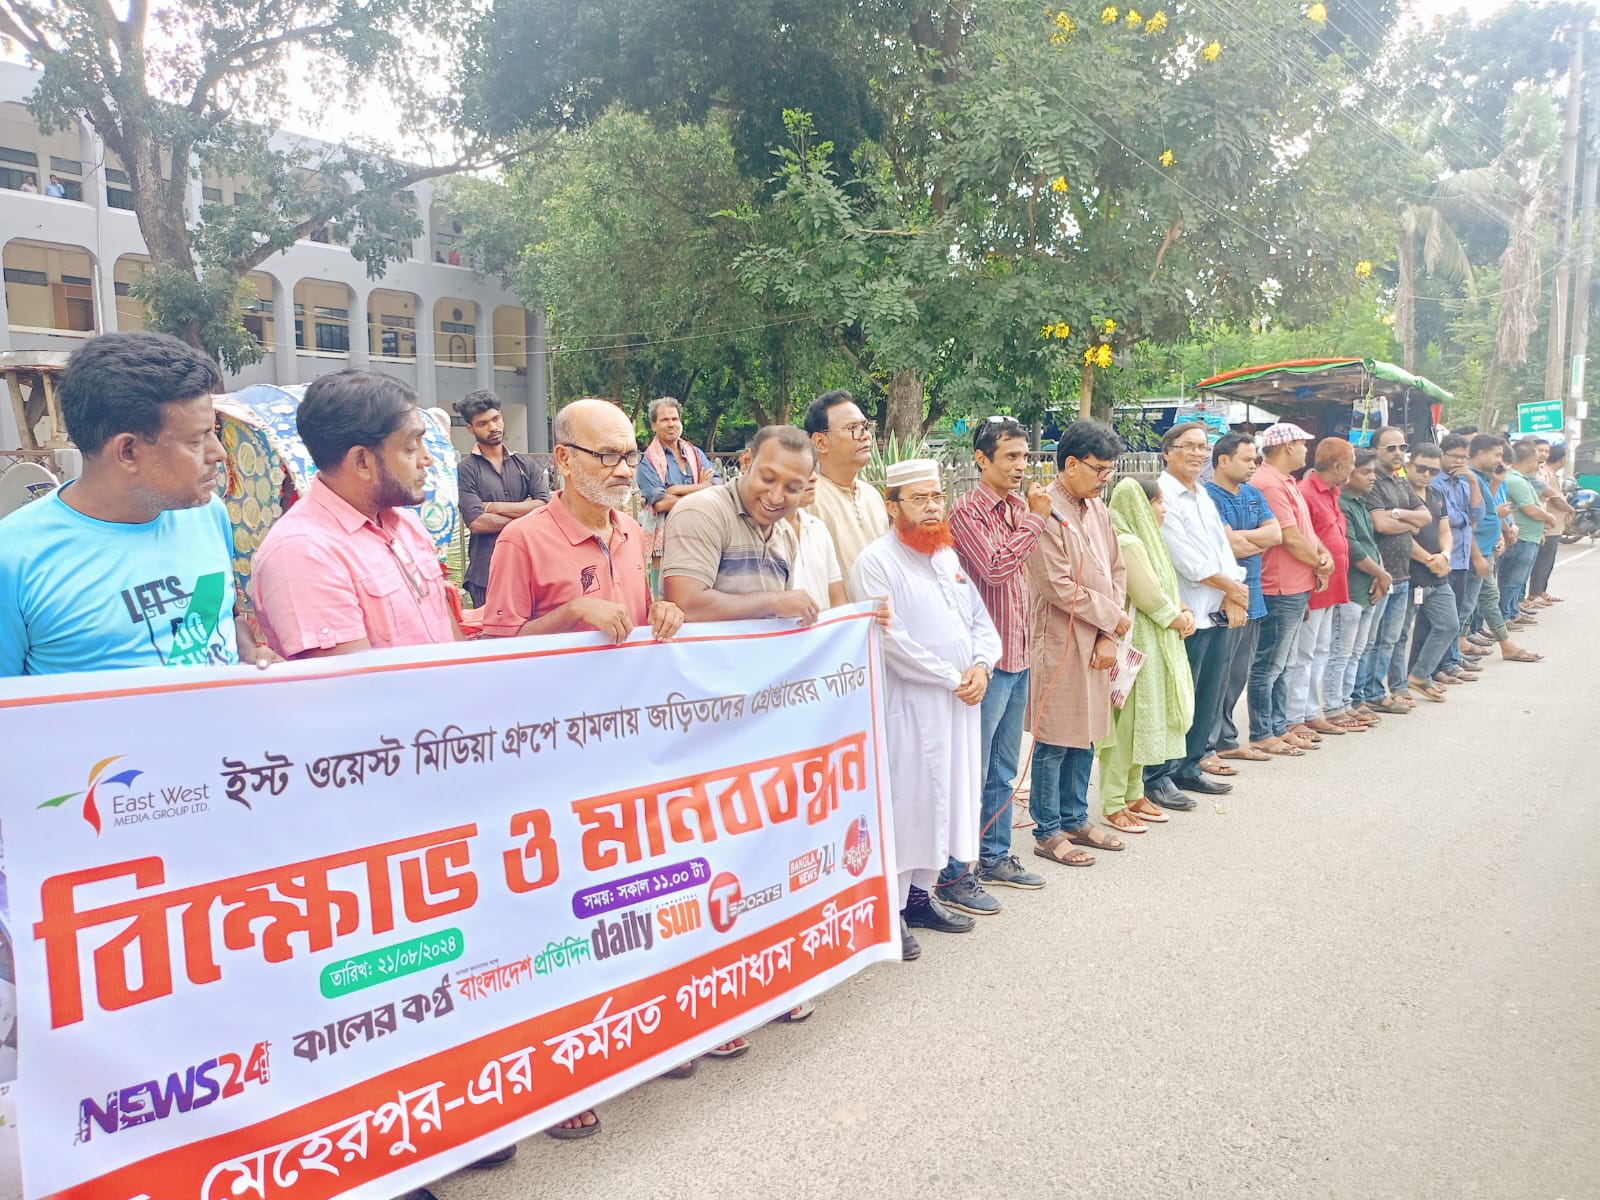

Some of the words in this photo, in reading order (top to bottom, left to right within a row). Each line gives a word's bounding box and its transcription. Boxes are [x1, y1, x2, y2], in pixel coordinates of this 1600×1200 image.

[121, 575, 189, 624] LET'S
[220, 751, 294, 810] ইস্ট
[305, 735, 405, 788] ওয়েস্ট
[412, 724, 498, 774] মিডিয়া
[501, 717, 557, 758] গ্রুপে
[566, 705, 642, 747] হামলায়
[645, 691, 747, 733] জড়িতদের
[113, 791, 155, 814] East
[160, 783, 210, 806] West
[114, 812, 150, 827] MEDIA
[152, 804, 189, 820] GROUP
[191, 802, 210, 813] LTD.
[33, 822, 479, 1030] বিক্ষোভ
[503, 808, 560, 894] ও
[571, 730, 867, 872] মানববন্ধন
[582, 888, 615, 910] সময়:
[616, 879, 650, 900] সকাল
[653, 870, 690, 892] ১১.০০
[690, 861, 706, 879] টা
[790, 851, 817, 875] BANGLA
[798, 867, 818, 886] NEWS
[729, 885, 782, 918] SPORTS
[591, 910, 654, 961] daily
[656, 897, 702, 940] sun
[329, 960, 374, 987] তারিখ:
[378, 935, 457, 974] ২১/০৮/২০২৪
[456, 954, 533, 1002] বাংলাদেশ
[534, 936, 591, 976] প্রতিদিন
[543, 996, 668, 1076] কর্মরত
[676, 936, 796, 1021] গণমাধ্যম
[800, 896, 878, 963] কর্মীবৃন্দ
[292, 1002, 398, 1063] কালের
[74, 1040, 271, 1146] NEWS24
